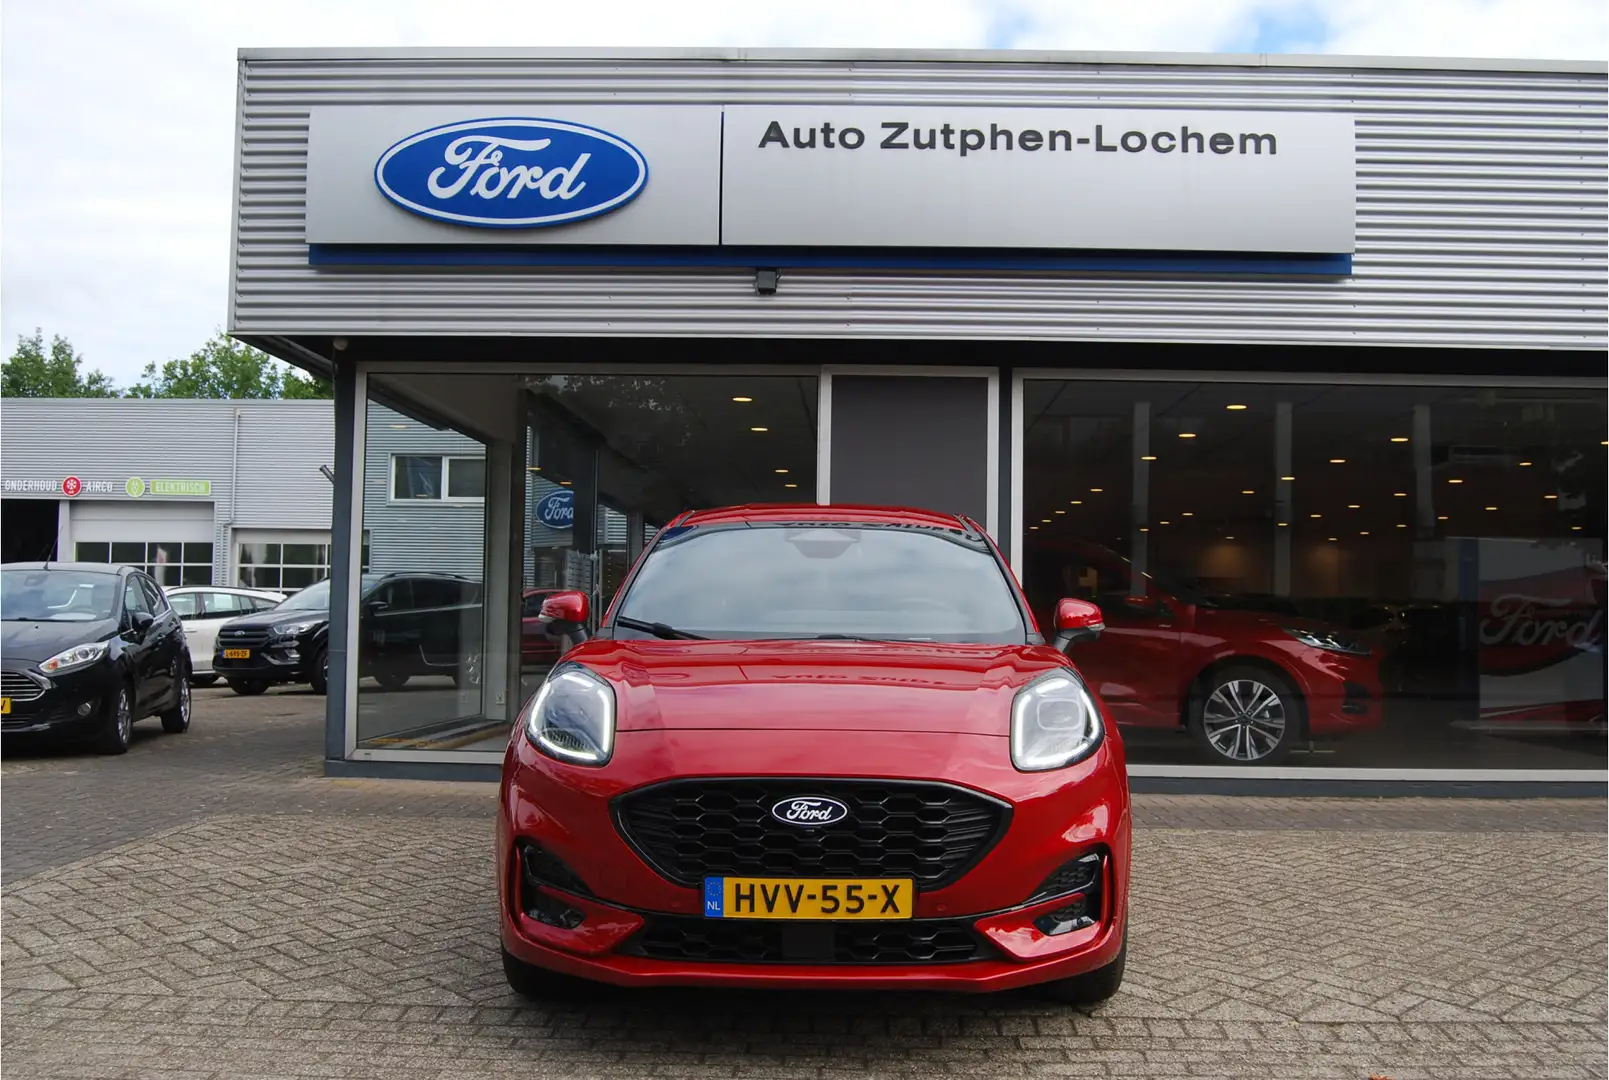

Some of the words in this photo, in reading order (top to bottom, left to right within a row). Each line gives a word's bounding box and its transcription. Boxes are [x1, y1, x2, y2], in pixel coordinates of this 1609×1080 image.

[758, 121, 866, 150] Auto
[880, 121, 1277, 157] Zutphen-Lochem
[427, 135, 592, 200] Ford
[5, 480, 58, 491] ONDERHOUD
[85, 481, 113, 493] AIRCO
[155, 481, 206, 493] ELEKTRISCH
[1480, 594, 1604, 646] Ford
[786, 800, 832, 821] Ford
[706, 900, 721, 911] NL
[734, 883, 900, 914] HVV-55-X
